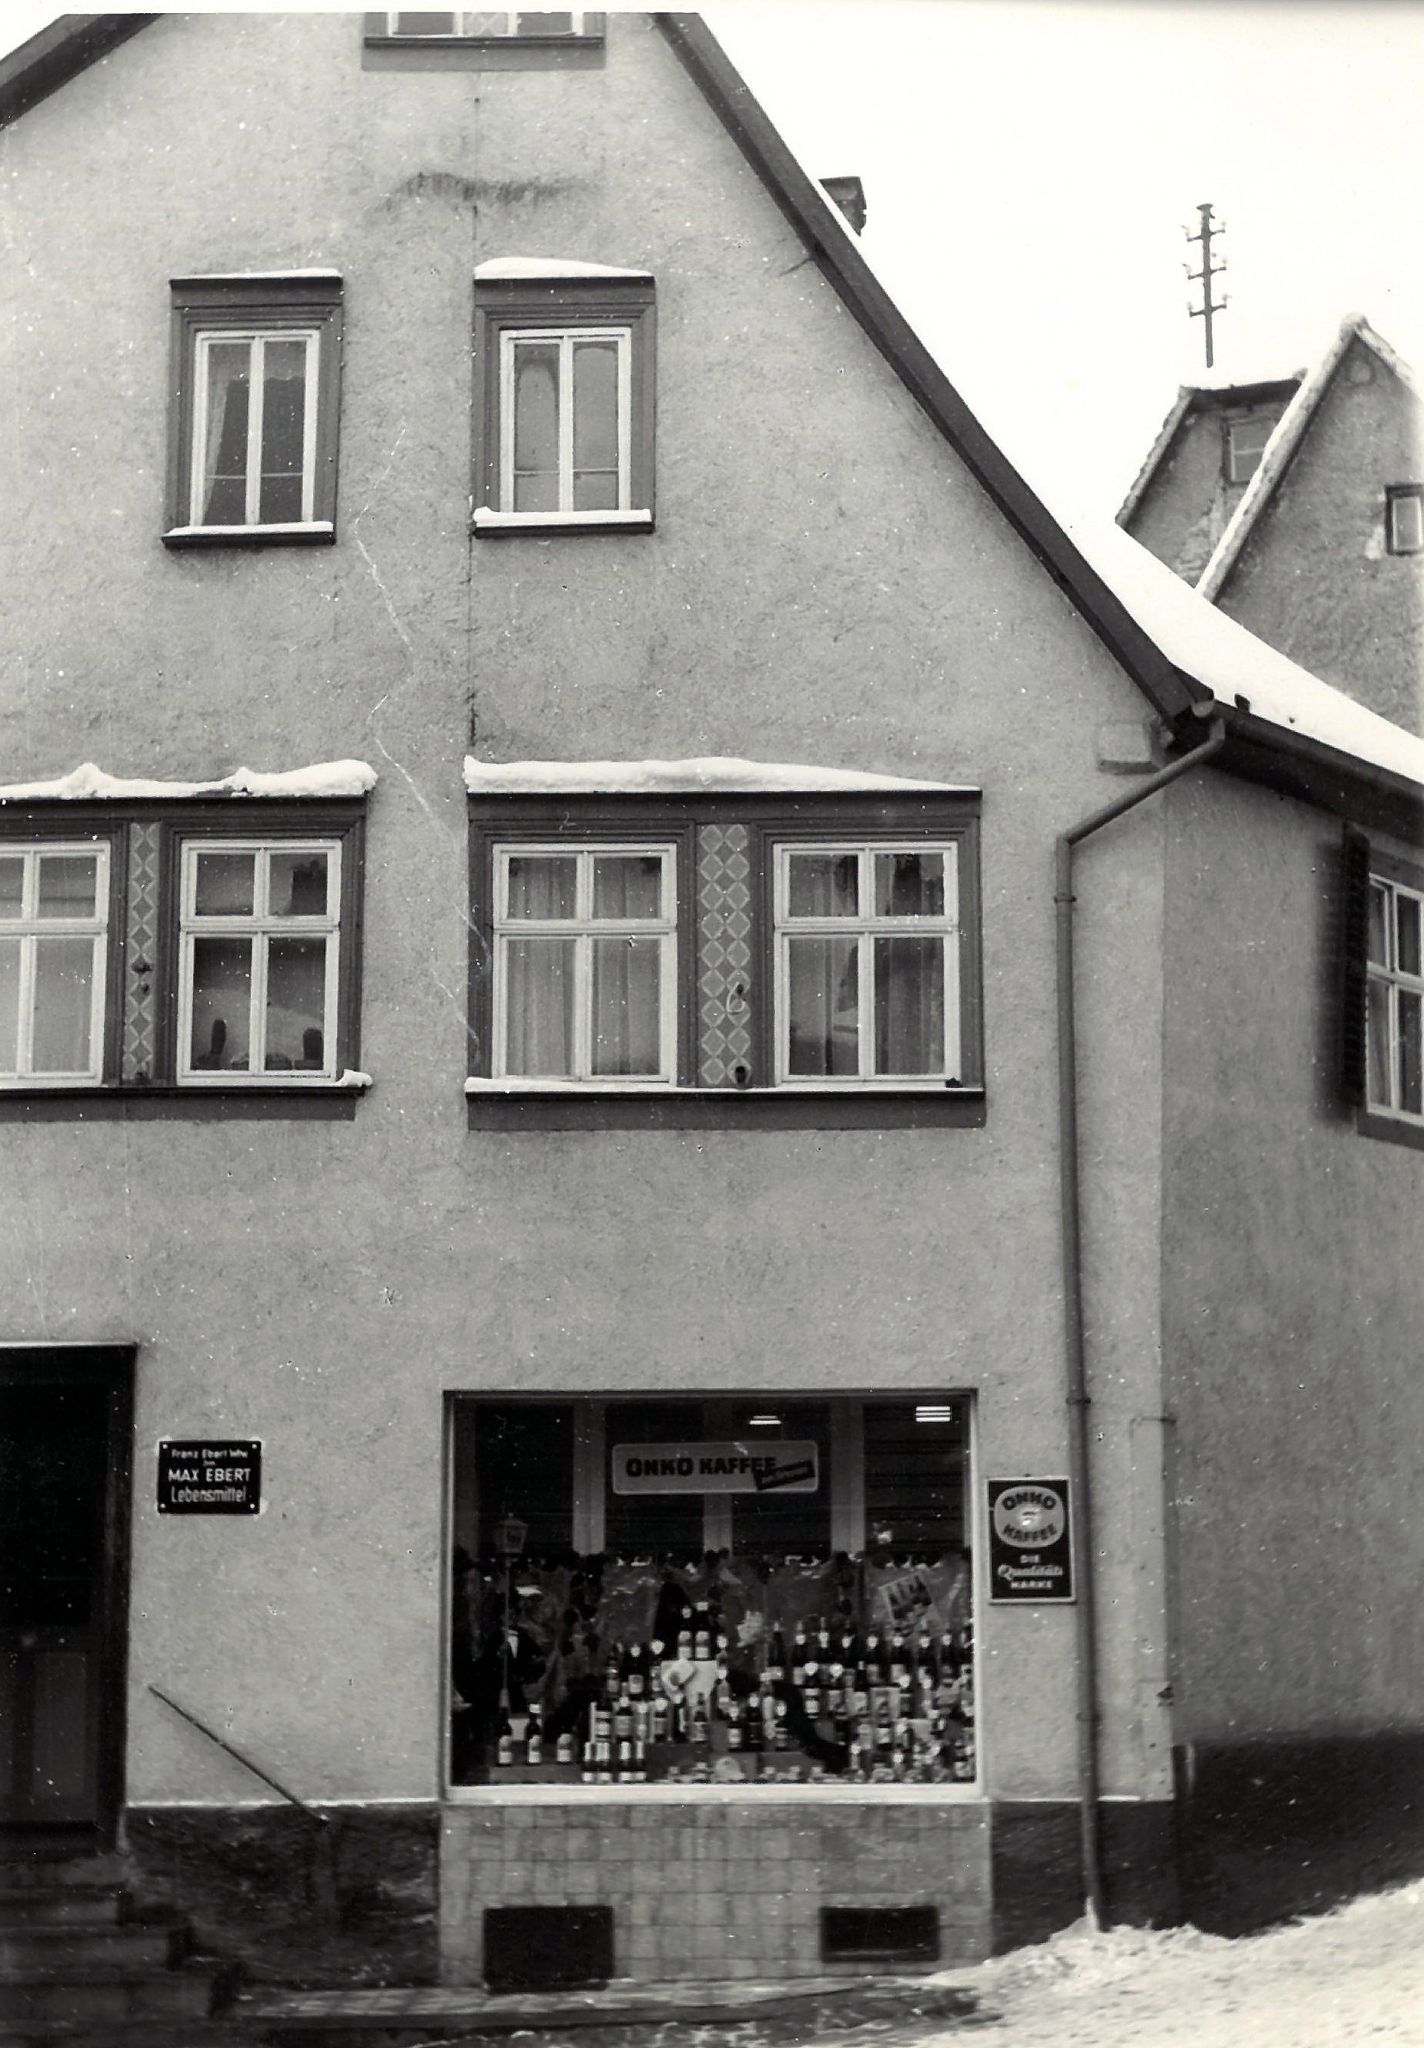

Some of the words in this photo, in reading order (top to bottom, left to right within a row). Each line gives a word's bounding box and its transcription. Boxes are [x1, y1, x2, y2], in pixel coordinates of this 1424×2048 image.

[168, 1468, 199, 1482] MAX
[206, 1468, 251, 1482] EBERT
[626, 1458, 694, 1477] ONKO
[700, 1457, 776, 1475] KAFFEE
[171, 1486, 246, 1502] Lebensmittel
[1002, 1492, 1057, 1511] ONKO
